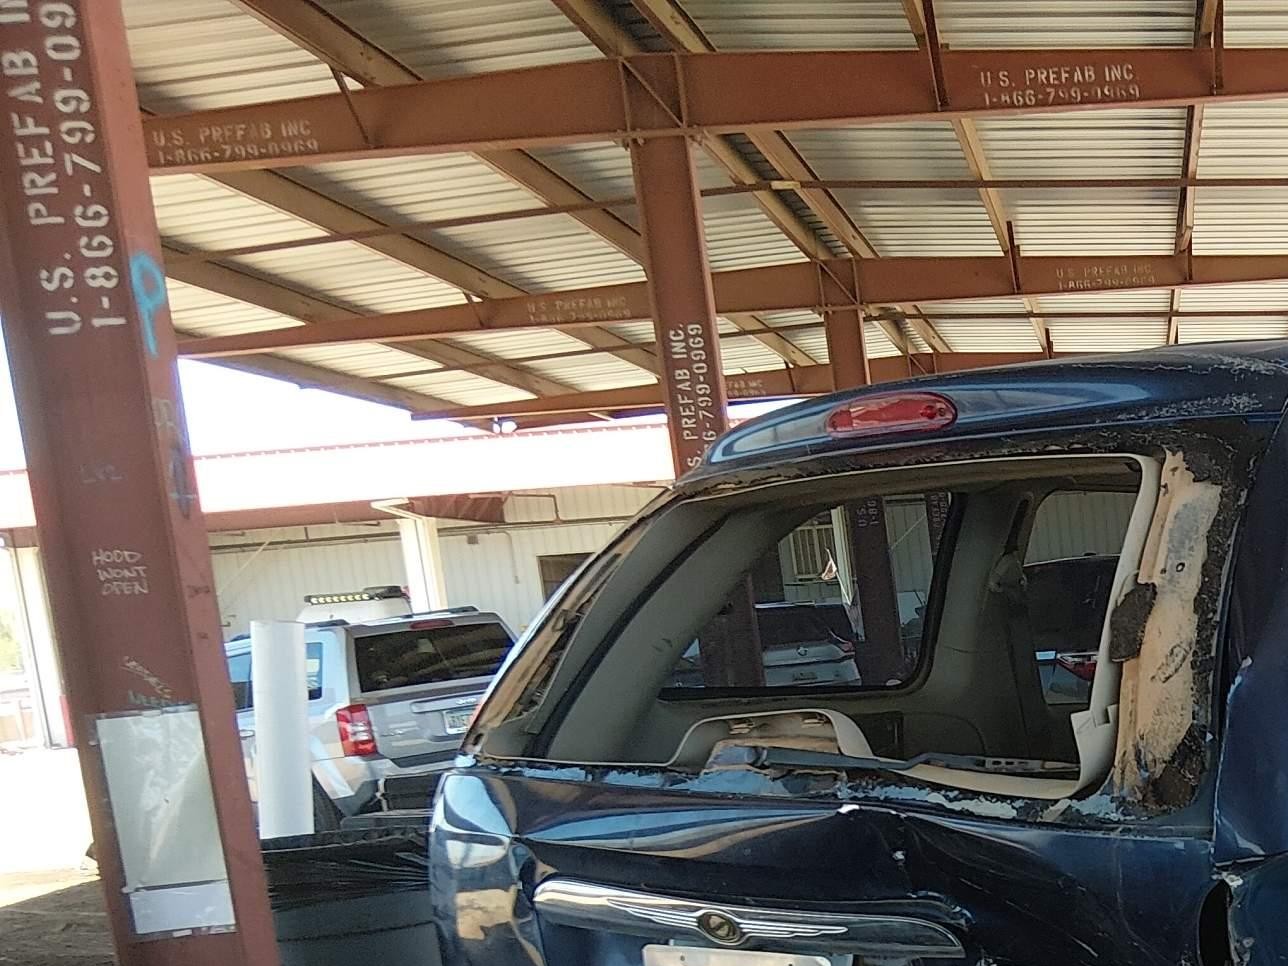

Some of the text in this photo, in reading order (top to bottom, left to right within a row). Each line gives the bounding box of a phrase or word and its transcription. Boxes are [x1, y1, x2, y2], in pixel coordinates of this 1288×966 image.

[1025, 65, 1096, 85] PREFAB
[2, 49, 66, 226] PREFAB
[281, 119, 312, 137] INC
[40, 252, 82, 335] U.S.
[674, 368, 699, 440] PREFAB
[92, 549, 142, 566] HOOD
